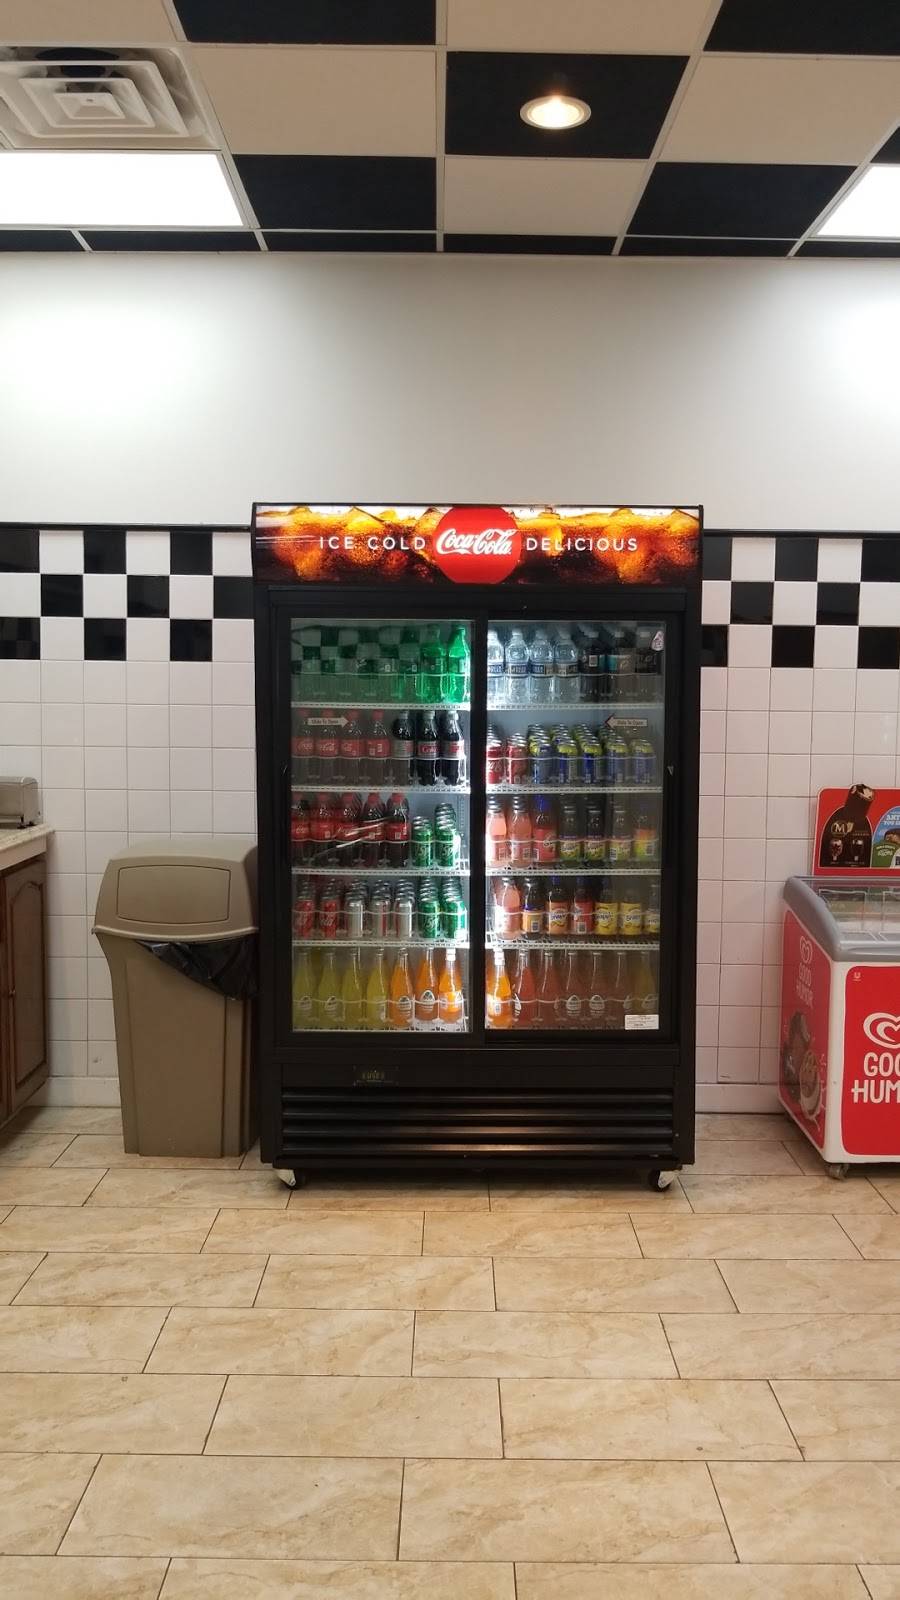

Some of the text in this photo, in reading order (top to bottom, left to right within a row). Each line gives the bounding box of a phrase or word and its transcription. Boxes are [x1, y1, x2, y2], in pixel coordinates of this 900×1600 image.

[319, 536, 426, 550] ICE COLD
[436, 528, 517, 555] Coca-Cola
[526, 537, 638, 551] DELICIOUS
